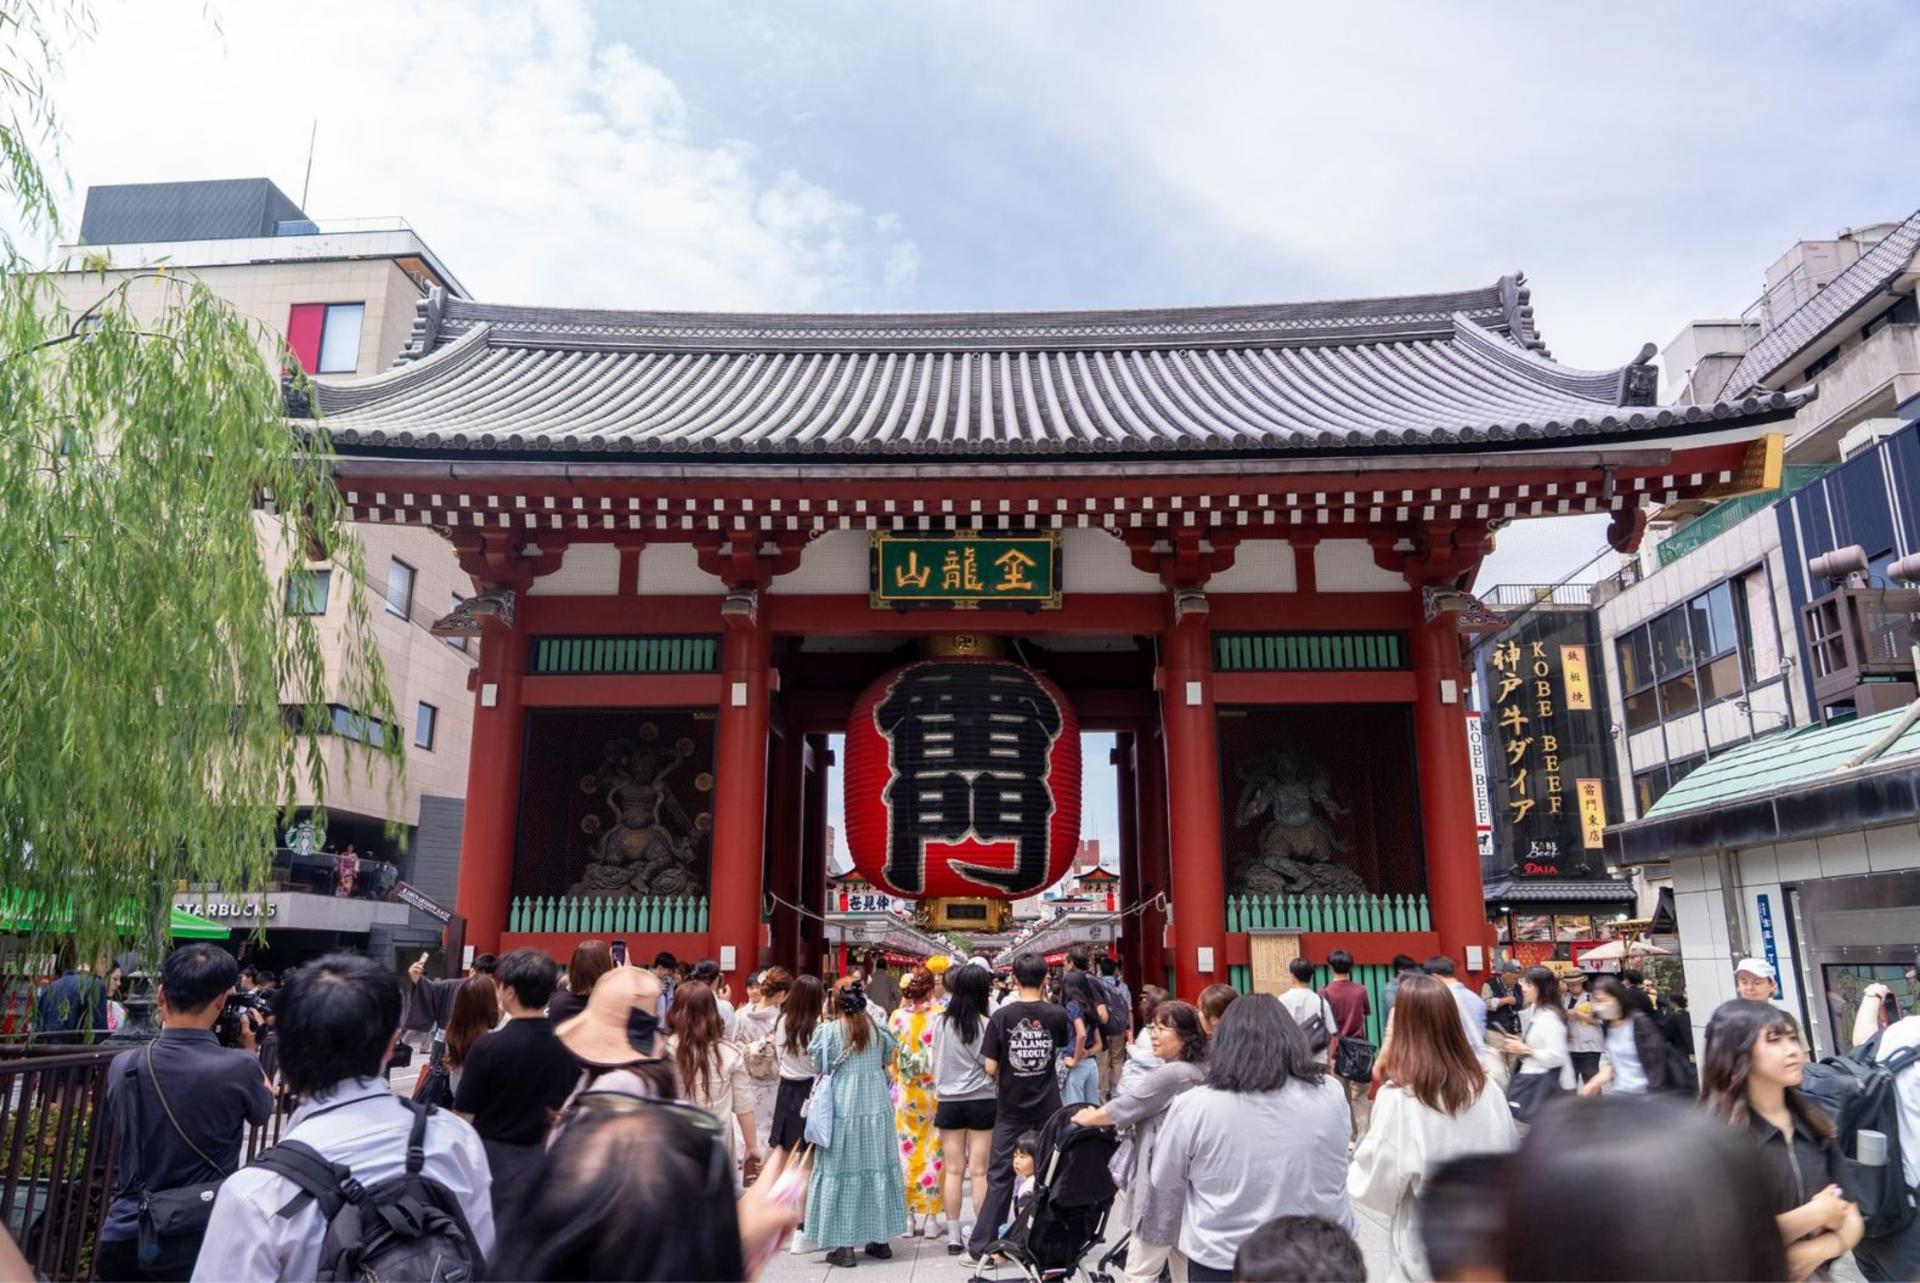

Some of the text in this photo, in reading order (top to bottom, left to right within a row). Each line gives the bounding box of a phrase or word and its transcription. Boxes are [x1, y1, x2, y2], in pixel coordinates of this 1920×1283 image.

[896, 547, 1036, 591] 金龍山
[1493, 640, 1535, 823] 神戸牛ダイア
[1532, 641, 1562, 814] KOBE BEEF
[872, 661, 1063, 893] 雷門
[1469, 720, 1487, 823] KOBE BEEF
[1583, 784, 1600, 842] 雷門東店
[1016, 1049, 1046, 1058] SEOUL
[1021, 1031, 1042, 1040] NEW
